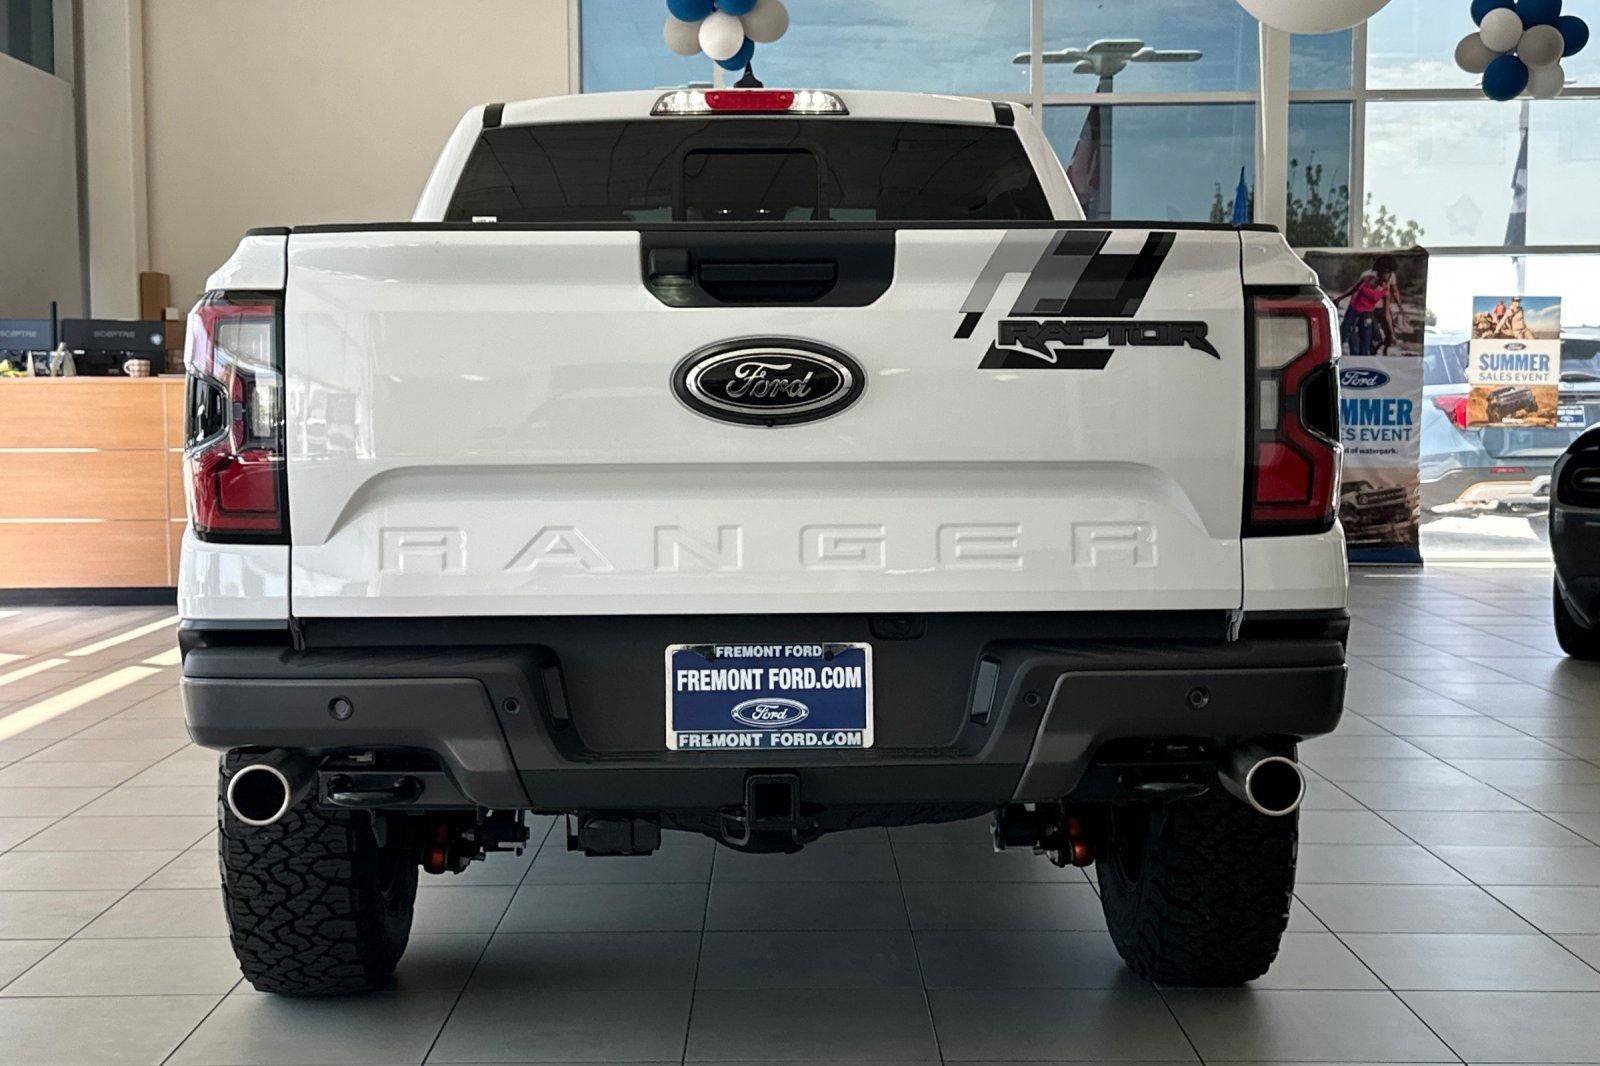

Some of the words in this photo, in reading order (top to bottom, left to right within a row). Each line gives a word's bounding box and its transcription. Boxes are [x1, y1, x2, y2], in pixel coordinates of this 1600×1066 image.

[94, 330, 136, 338] SCEPTRE
[997, 320, 1221, 361] RAPTOR
[1479, 353, 1550, 371] SUMMER
[726, 361, 814, 398] Ford
[1341, 371, 1379, 386] Ford
[1479, 372, 1514, 381] SALES
[1515, 372, 1550, 381] EVENT
[1341, 398, 1413, 425] MMER
[1360, 428, 1412, 441] EVENT
[1359, 447, 1398, 456] waterpark.
[379, 522, 1159, 574] RANGER
[715, 645, 782, 658] FREMONT
[784, 645, 823, 658] FORD
[677, 668, 764, 691] FREMONT
[768, 666, 862, 690] FORD.COM
[752, 704, 787, 720] Ford
[679, 734, 763, 747] FREMONT
[770, 732, 862, 746] FORD.COM
